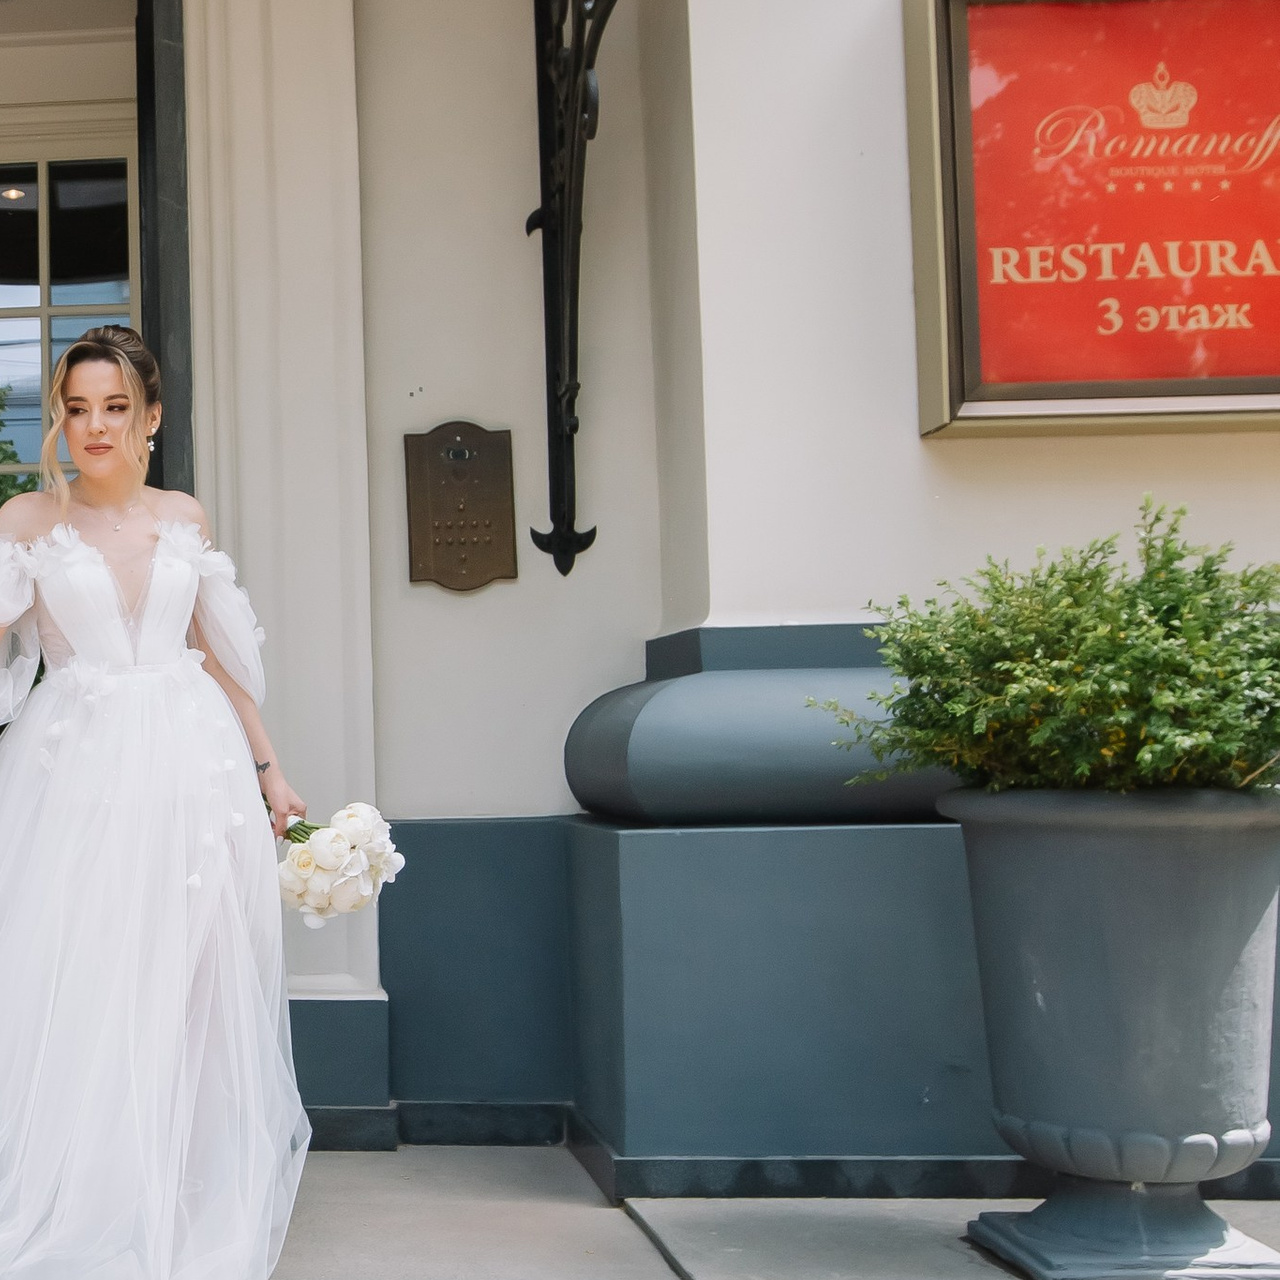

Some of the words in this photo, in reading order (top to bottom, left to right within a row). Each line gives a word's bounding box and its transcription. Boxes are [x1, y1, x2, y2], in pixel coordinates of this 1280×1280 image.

[1034, 105, 1280, 174] Romanoff
[989, 238, 1280, 284] RESTAURA
[1097, 298, 1124, 336] 3
[1136, 302, 1253, 332] этаж
